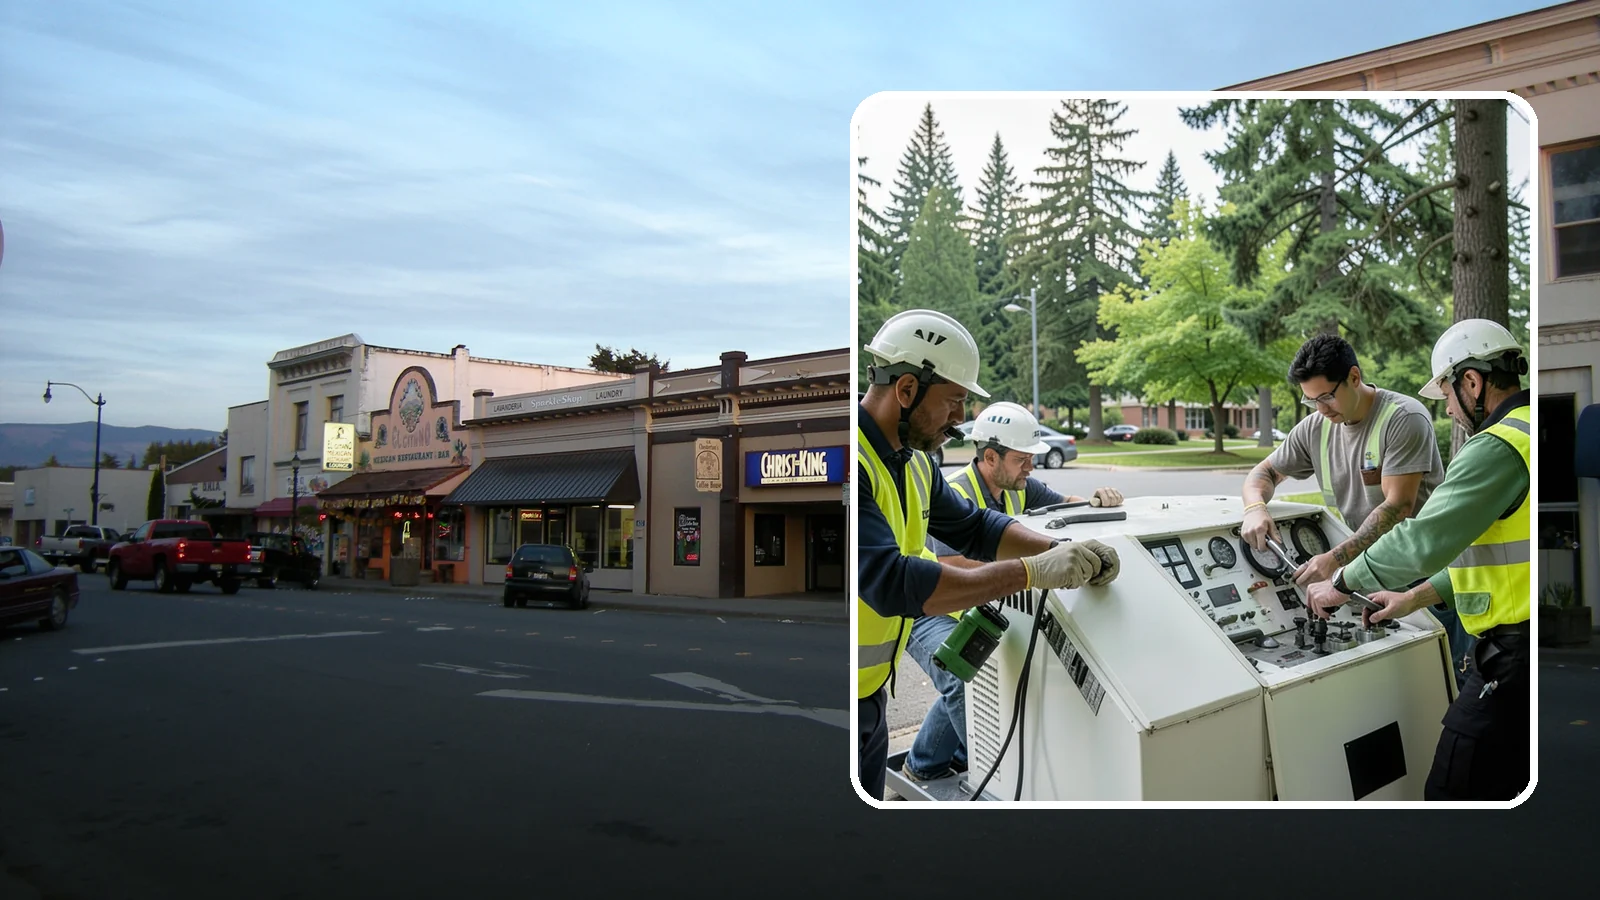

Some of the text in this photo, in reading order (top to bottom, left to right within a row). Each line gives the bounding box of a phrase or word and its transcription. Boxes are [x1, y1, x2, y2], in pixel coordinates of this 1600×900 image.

[531, 394, 583, 408] Sparkle Shop
[596, 389, 624, 400] LAUNDRY
[493, 402, 523, 412] LAVANDERIA
[373, 454, 396, 464] MEXICAN
[397, 451, 433, 463] RESTAURANT
[437, 450, 450, 459] BAR
[761, 449, 828, 478] CHRIST KING
